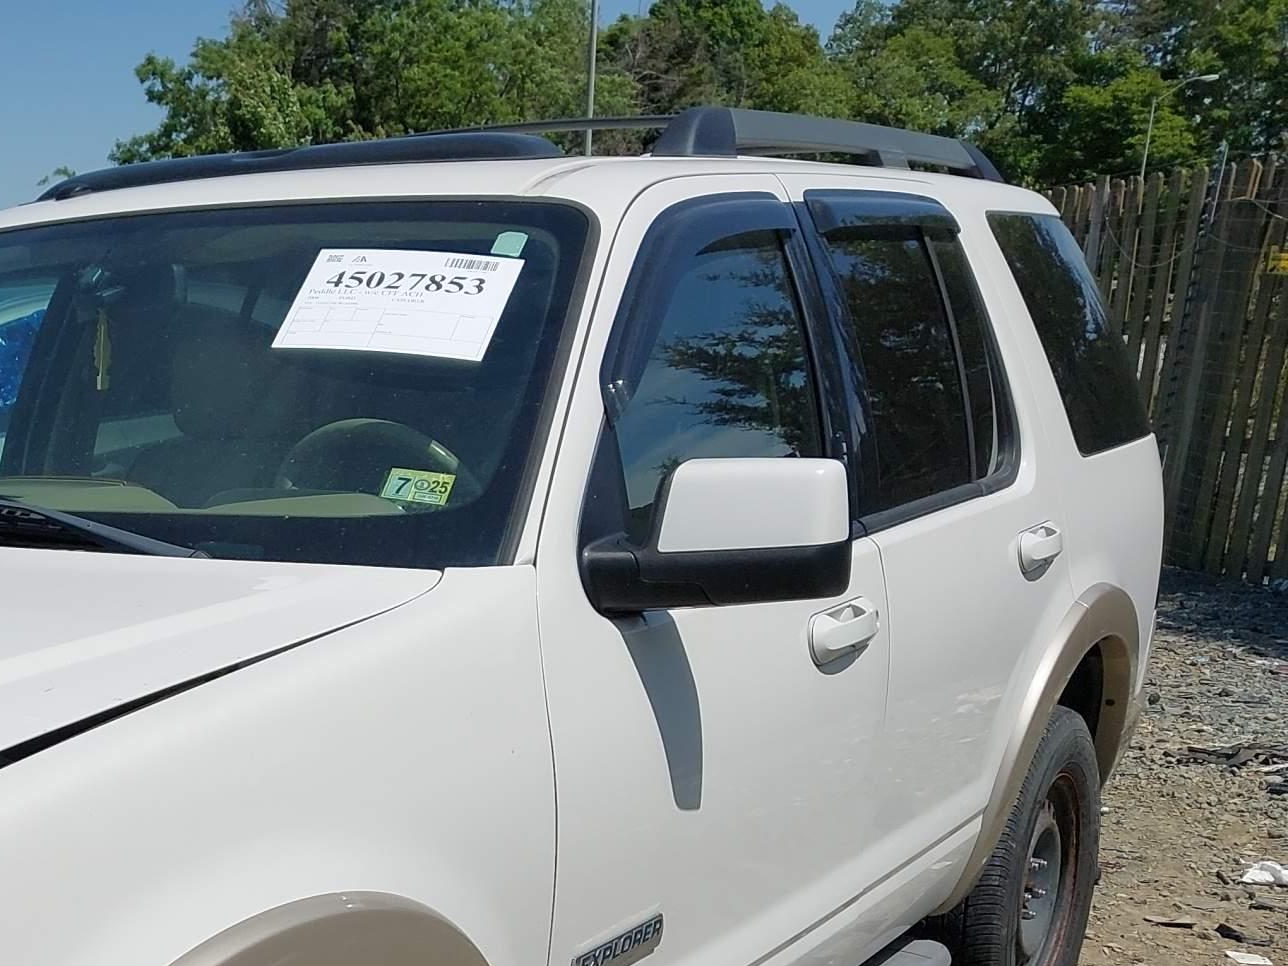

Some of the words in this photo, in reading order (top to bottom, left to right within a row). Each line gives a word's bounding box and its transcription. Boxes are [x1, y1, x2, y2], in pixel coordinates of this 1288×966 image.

[326, 270, 486, 296] 45027853
[395, 477, 411, 494] 7
[428, 480, 450, 495] 25
